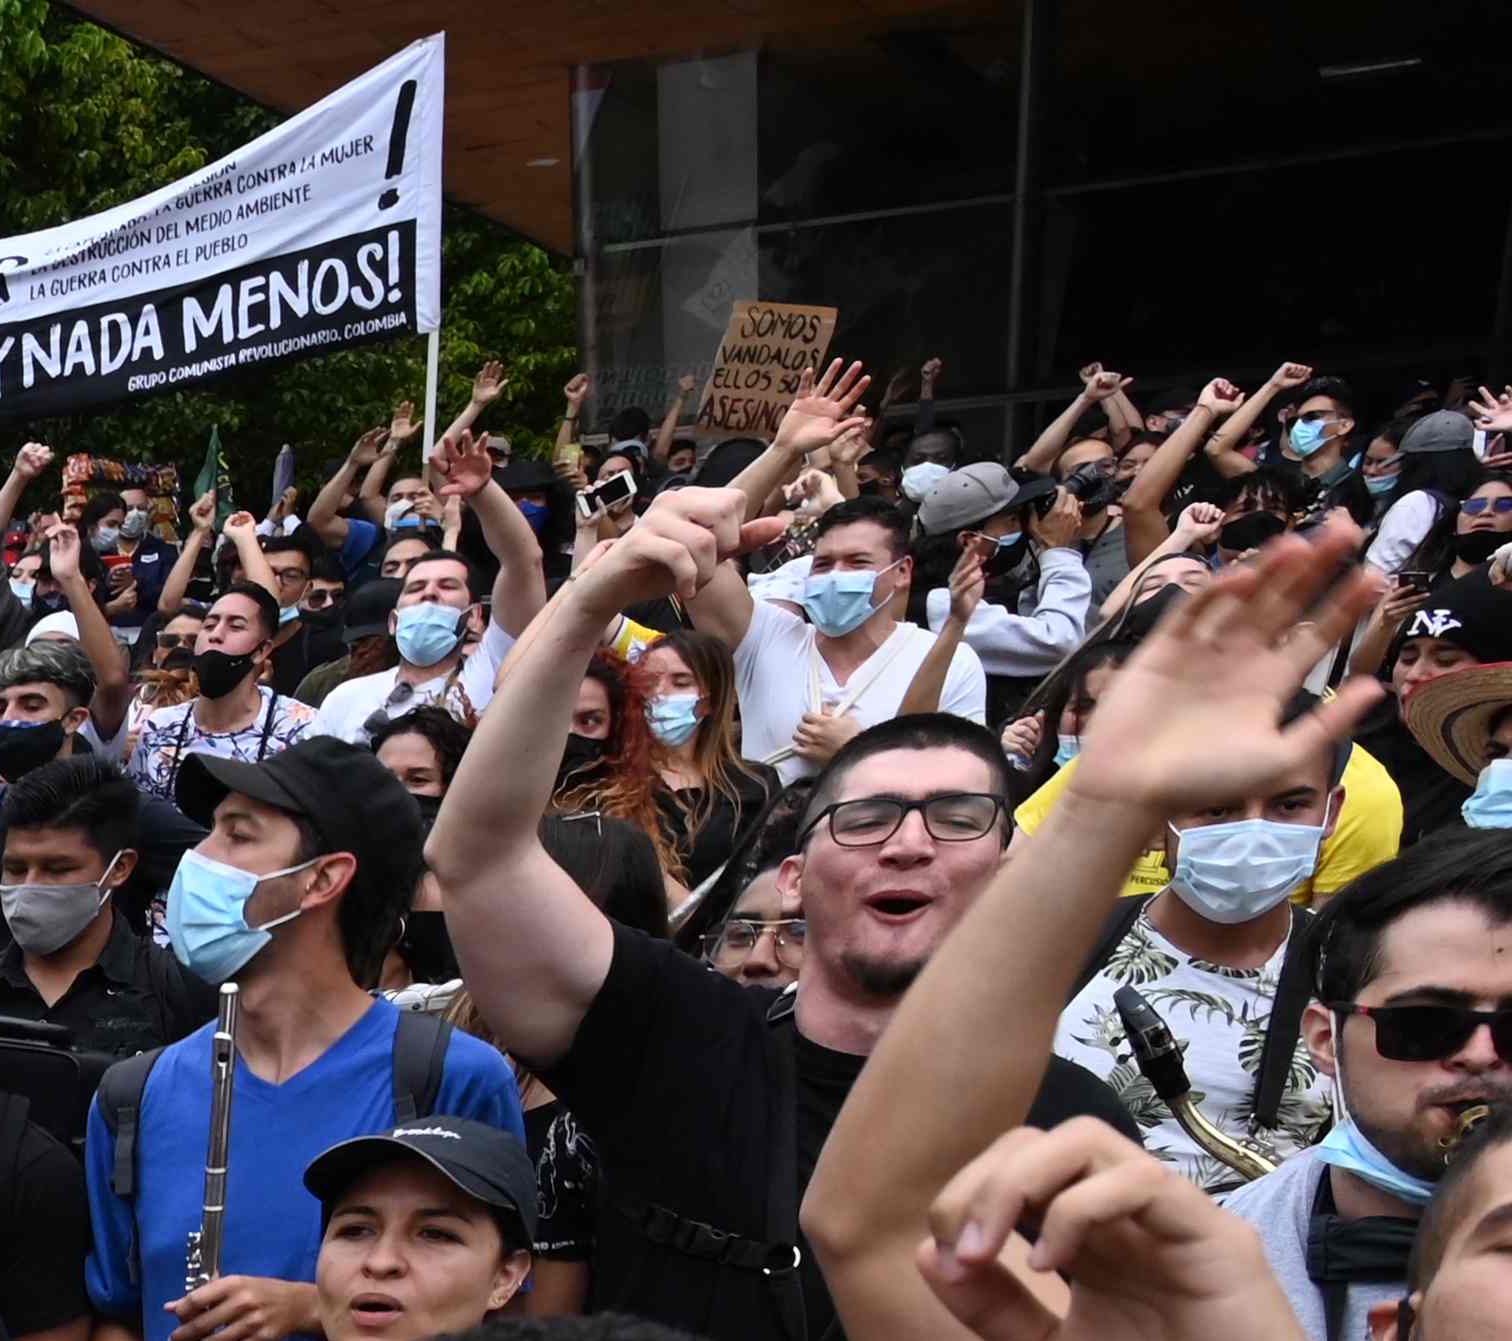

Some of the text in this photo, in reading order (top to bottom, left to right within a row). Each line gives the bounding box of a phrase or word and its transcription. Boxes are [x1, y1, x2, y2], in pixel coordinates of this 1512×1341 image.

[175, 178, 233, 212] GUERRA
[236, 159, 297, 196] CONTRA
[299, 154, 317, 175] LA
[319, 134, 375, 168] MUJER
[156, 224, 181, 245] DEL
[185, 209, 233, 235] MEDIO
[235, 184, 312, 222] AMBIENTE
[29, 233, 248, 301] LA GUERRA CONTRA EL PUEBLO
[22, 303, 165, 389] NADA
[182, 229, 403, 354] MENOS!
[740, 305, 822, 344] SOMOS
[127, 371, 167, 393] GRUPO
[168, 353, 238, 384] COMUNISTA
[343, 310, 407, 341] COLOMBIA
[712, 366, 772, 392] ELLOS
[721, 345, 820, 372] VANDALOS
[697, 395, 789, 431] ASESINO
